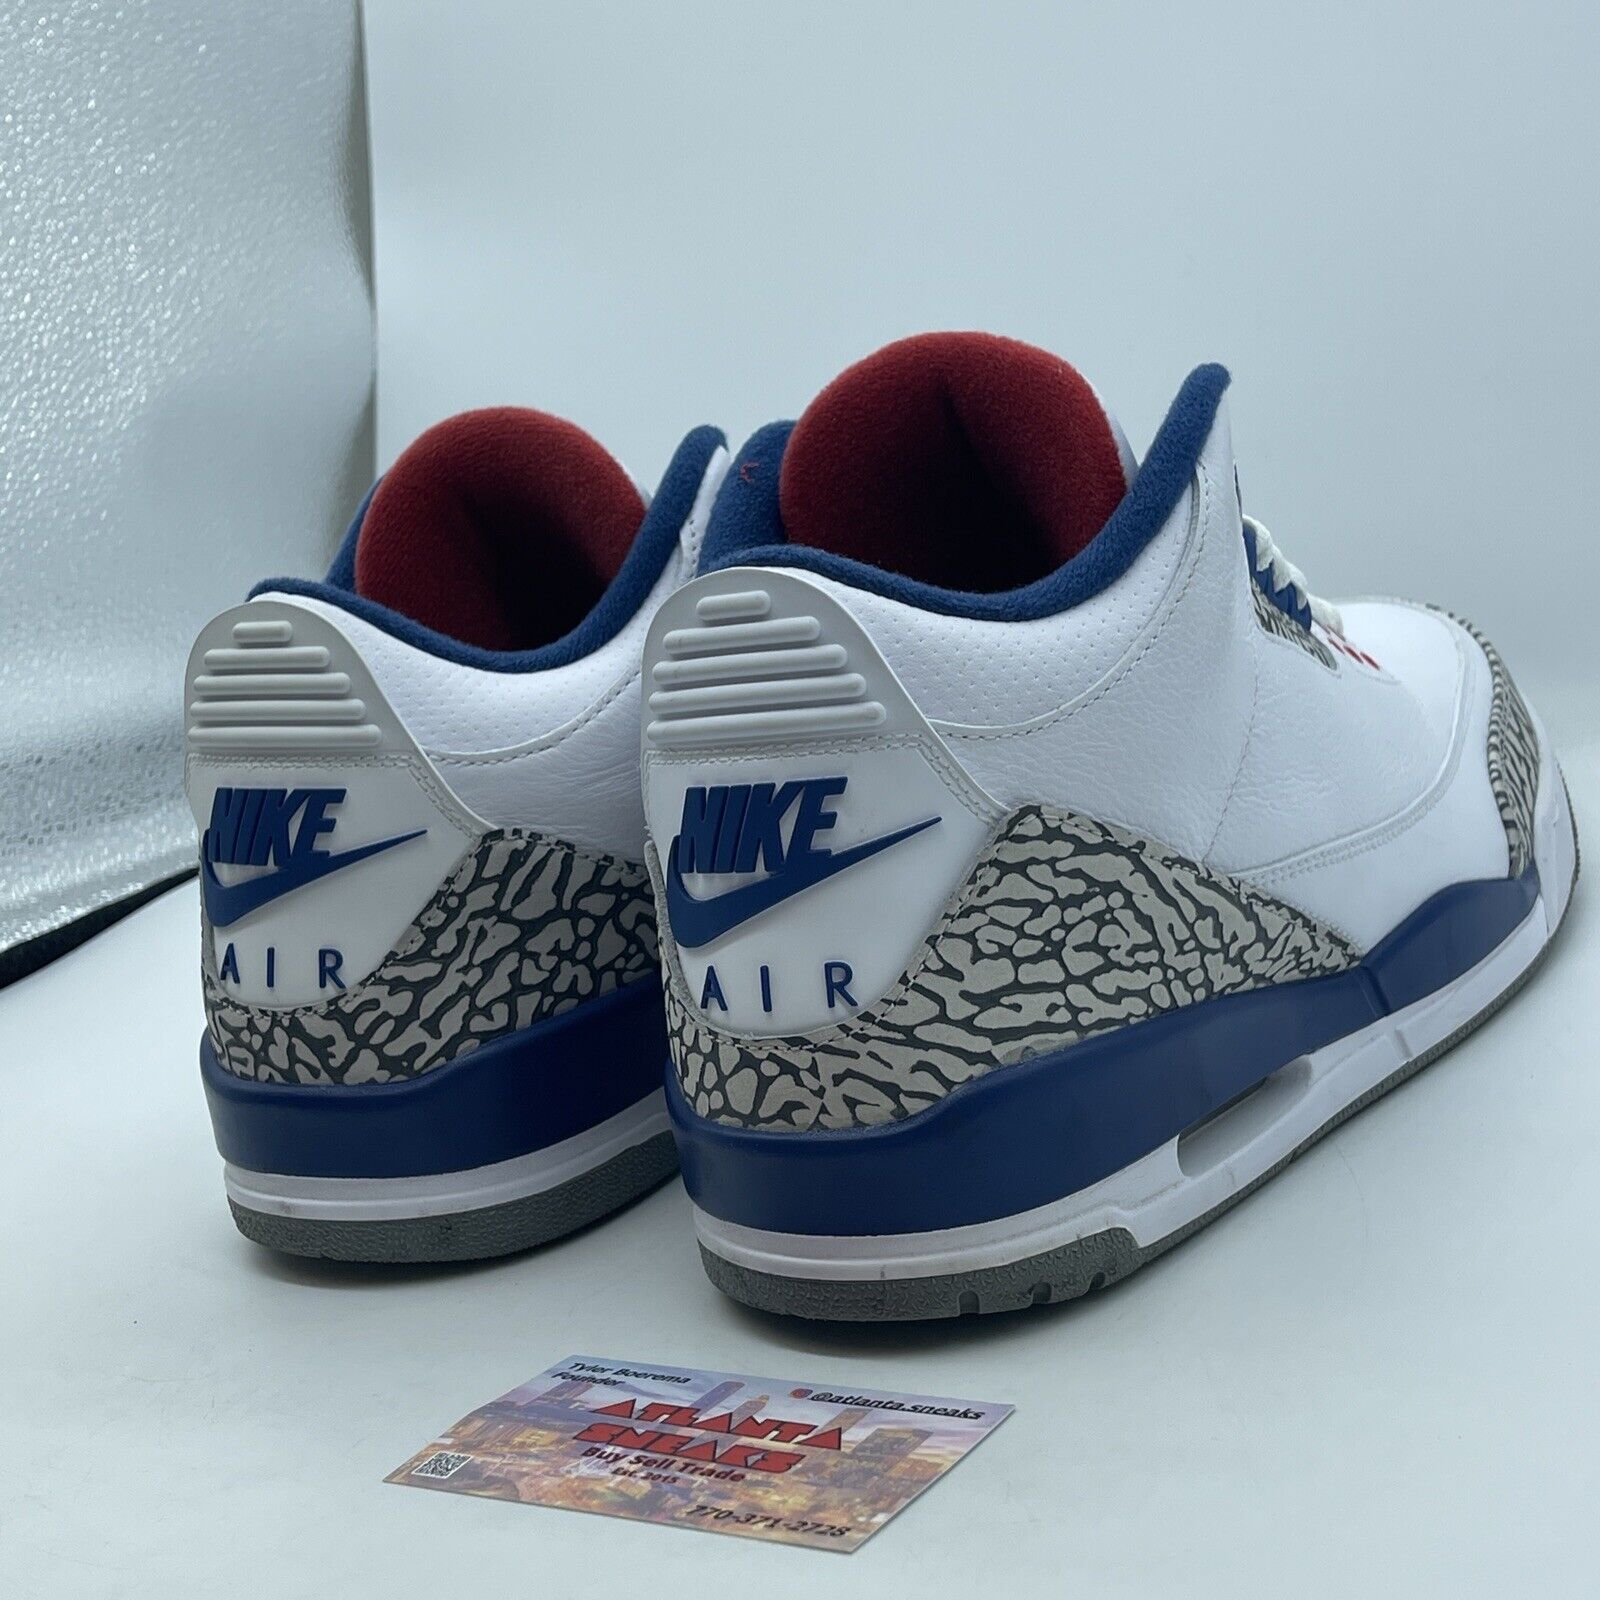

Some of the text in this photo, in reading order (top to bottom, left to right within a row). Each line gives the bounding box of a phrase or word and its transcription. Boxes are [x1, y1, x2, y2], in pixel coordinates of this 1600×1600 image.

[208, 787, 347, 868] NIKE
[678, 776, 848, 875] NIKE
[218, 942, 347, 989] AIR
[700, 961, 858, 1012] AIR
[551, 1371, 625, 1387] Founder
[569, 1362, 691, 1384] Tyler Boerema
[590, 1398, 842, 1450] ATLANTA
[810, 1391, 986, 1420] @atlanta.sneaks
[572, 1422, 806, 1474] SNEAKS
[581, 1446, 746, 1483] Buy Sell Trade
